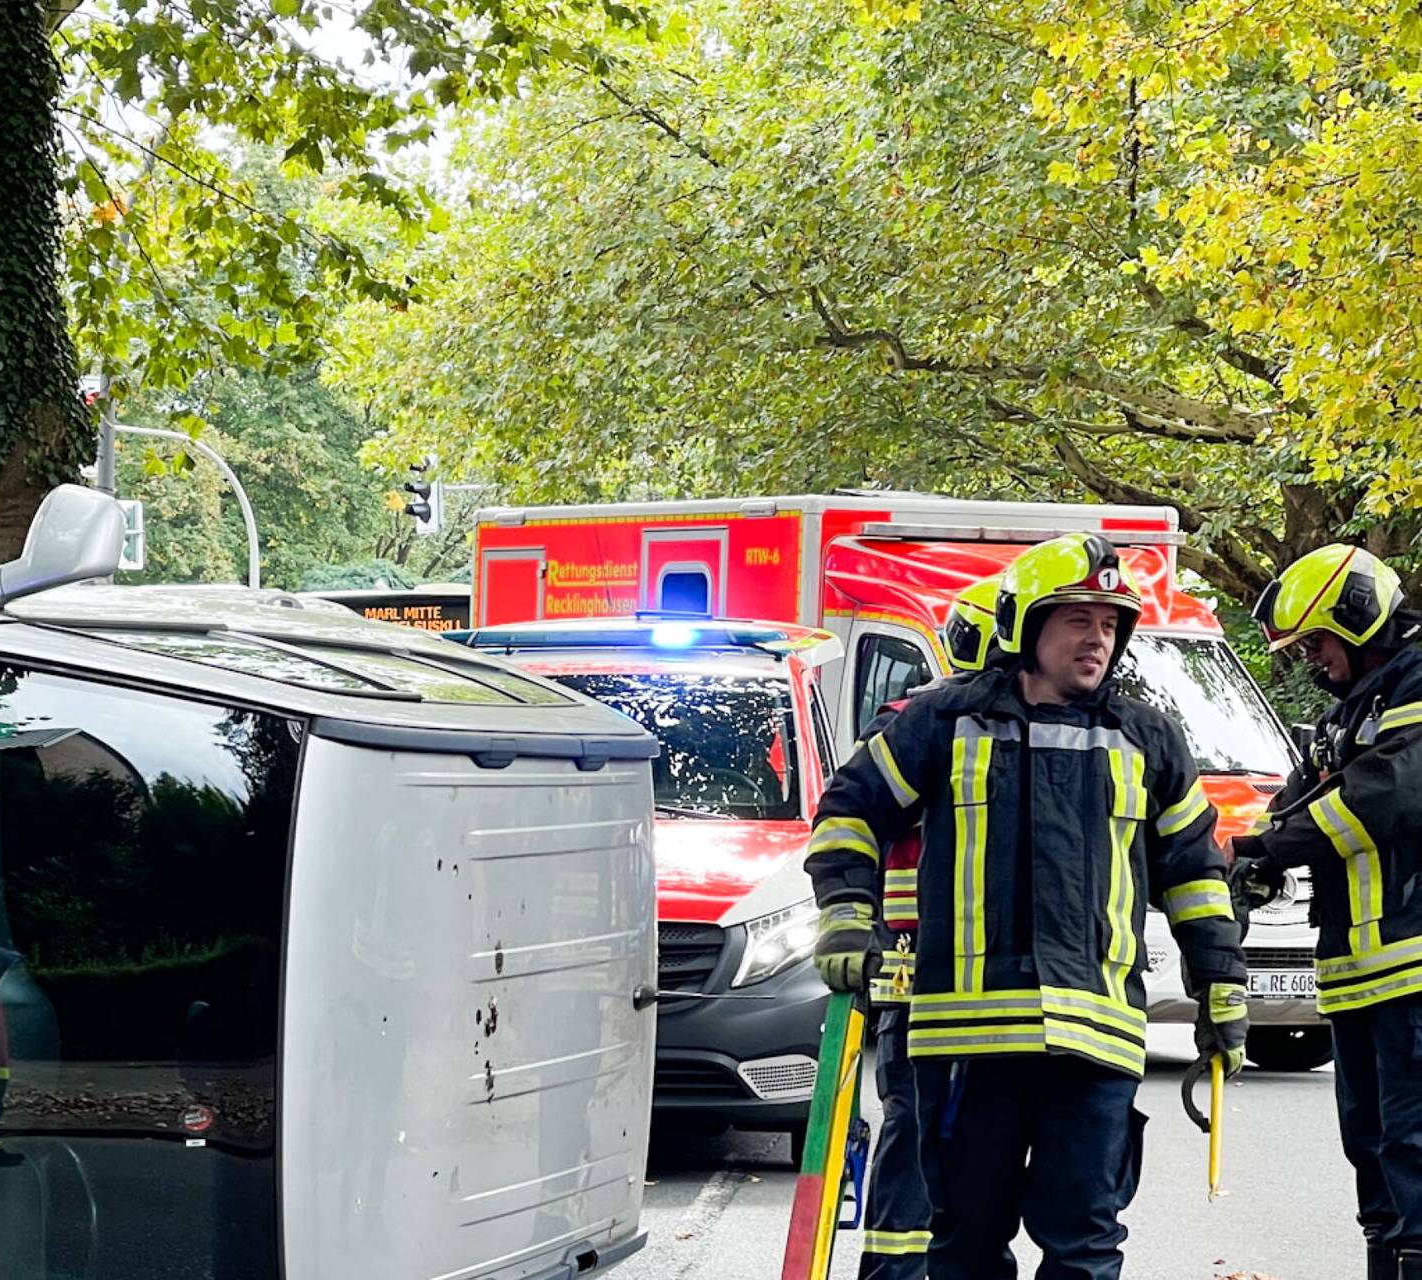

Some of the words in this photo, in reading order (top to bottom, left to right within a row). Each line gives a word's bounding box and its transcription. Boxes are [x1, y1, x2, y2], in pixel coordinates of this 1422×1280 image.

[745, 547, 780, 566] RTW-6
[546, 560, 638, 588] Rettungsdienst
[1103, 571, 1111, 588] 1
[364, 607, 401, 621] MARL
[403, 606, 442, 620] MITTE
[546, 592, 636, 618] Recklinghausen
[1245, 975, 1259, 992] E
[1270, 975, 1288, 992] RE
[1291, 975, 1315, 992] 608
